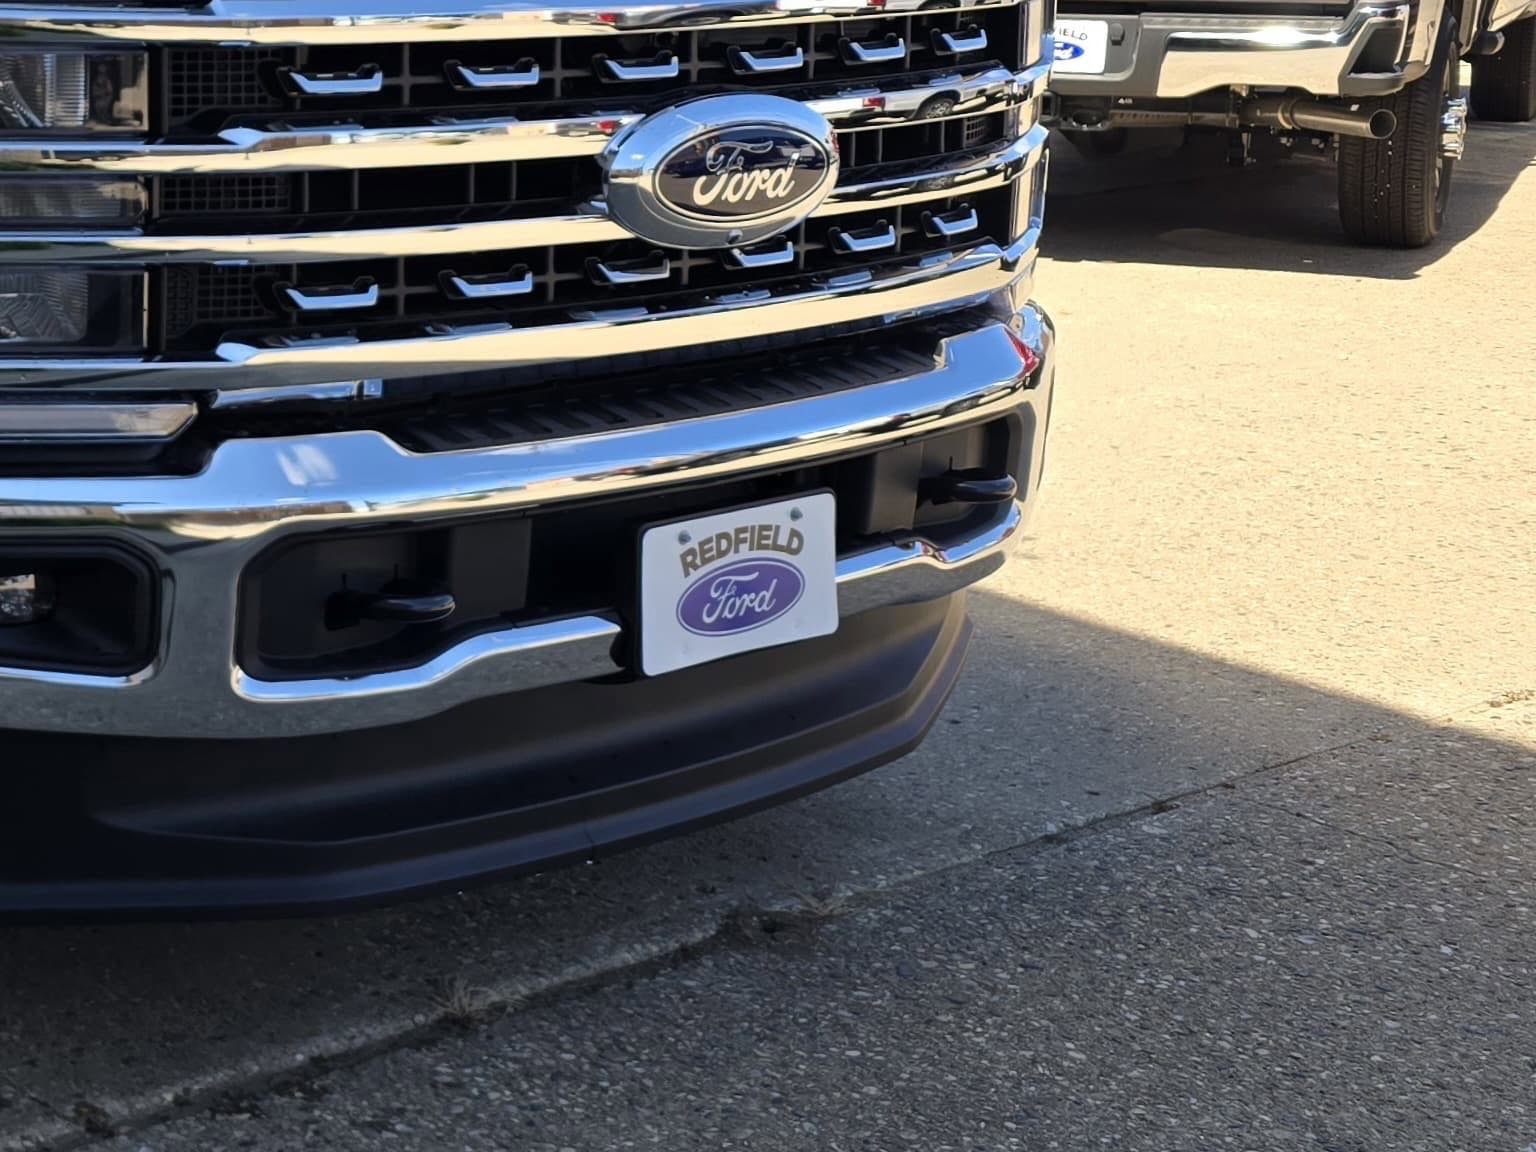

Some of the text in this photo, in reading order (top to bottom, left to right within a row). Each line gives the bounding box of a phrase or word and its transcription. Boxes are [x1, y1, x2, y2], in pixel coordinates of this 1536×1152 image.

[692, 140, 802, 206] Ford
[679, 523, 805, 579] REDFIELD
[701, 570, 779, 624] Ford
